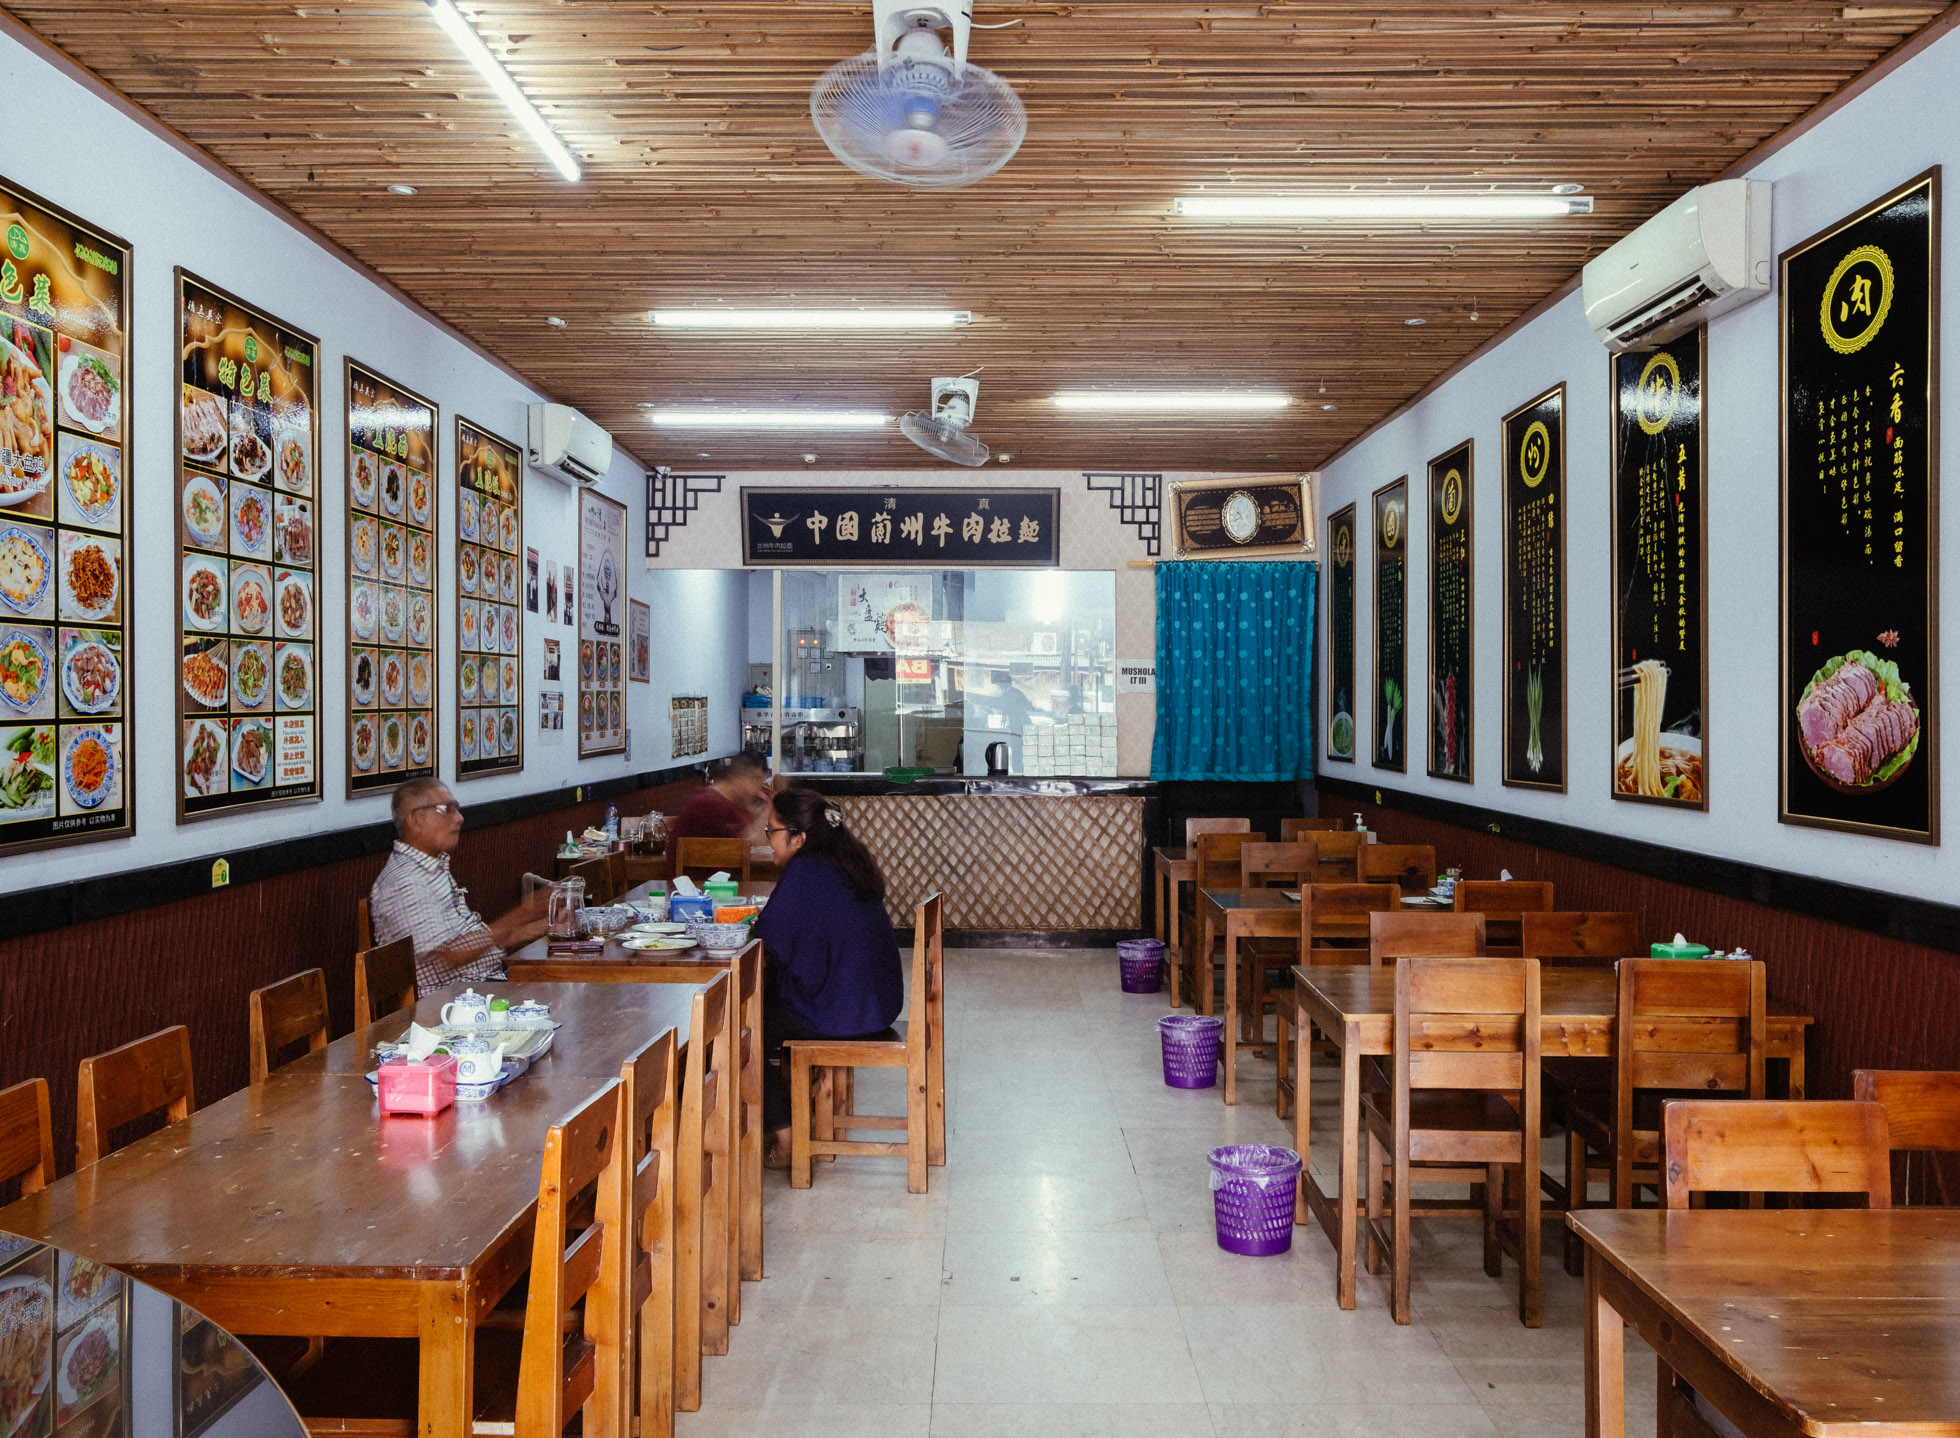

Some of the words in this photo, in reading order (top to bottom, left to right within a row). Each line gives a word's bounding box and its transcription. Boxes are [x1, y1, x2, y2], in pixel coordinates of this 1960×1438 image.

[1839, 274, 1872, 323] 肉
[218, 356, 274, 404] 特色菜
[0, 446, 45, 475] 疆大盘鸡
[884, 497, 897, 510] 清
[978, 497, 991, 510] 真
[1121, 667, 1156, 676] MUSHOLA
[1130, 676, 1137, 685] LT
[1138, 676, 1147, 685] III
[52, 817, 87, 831] 图片仅供参考
[88, 813, 116, 825] 以实物为准
